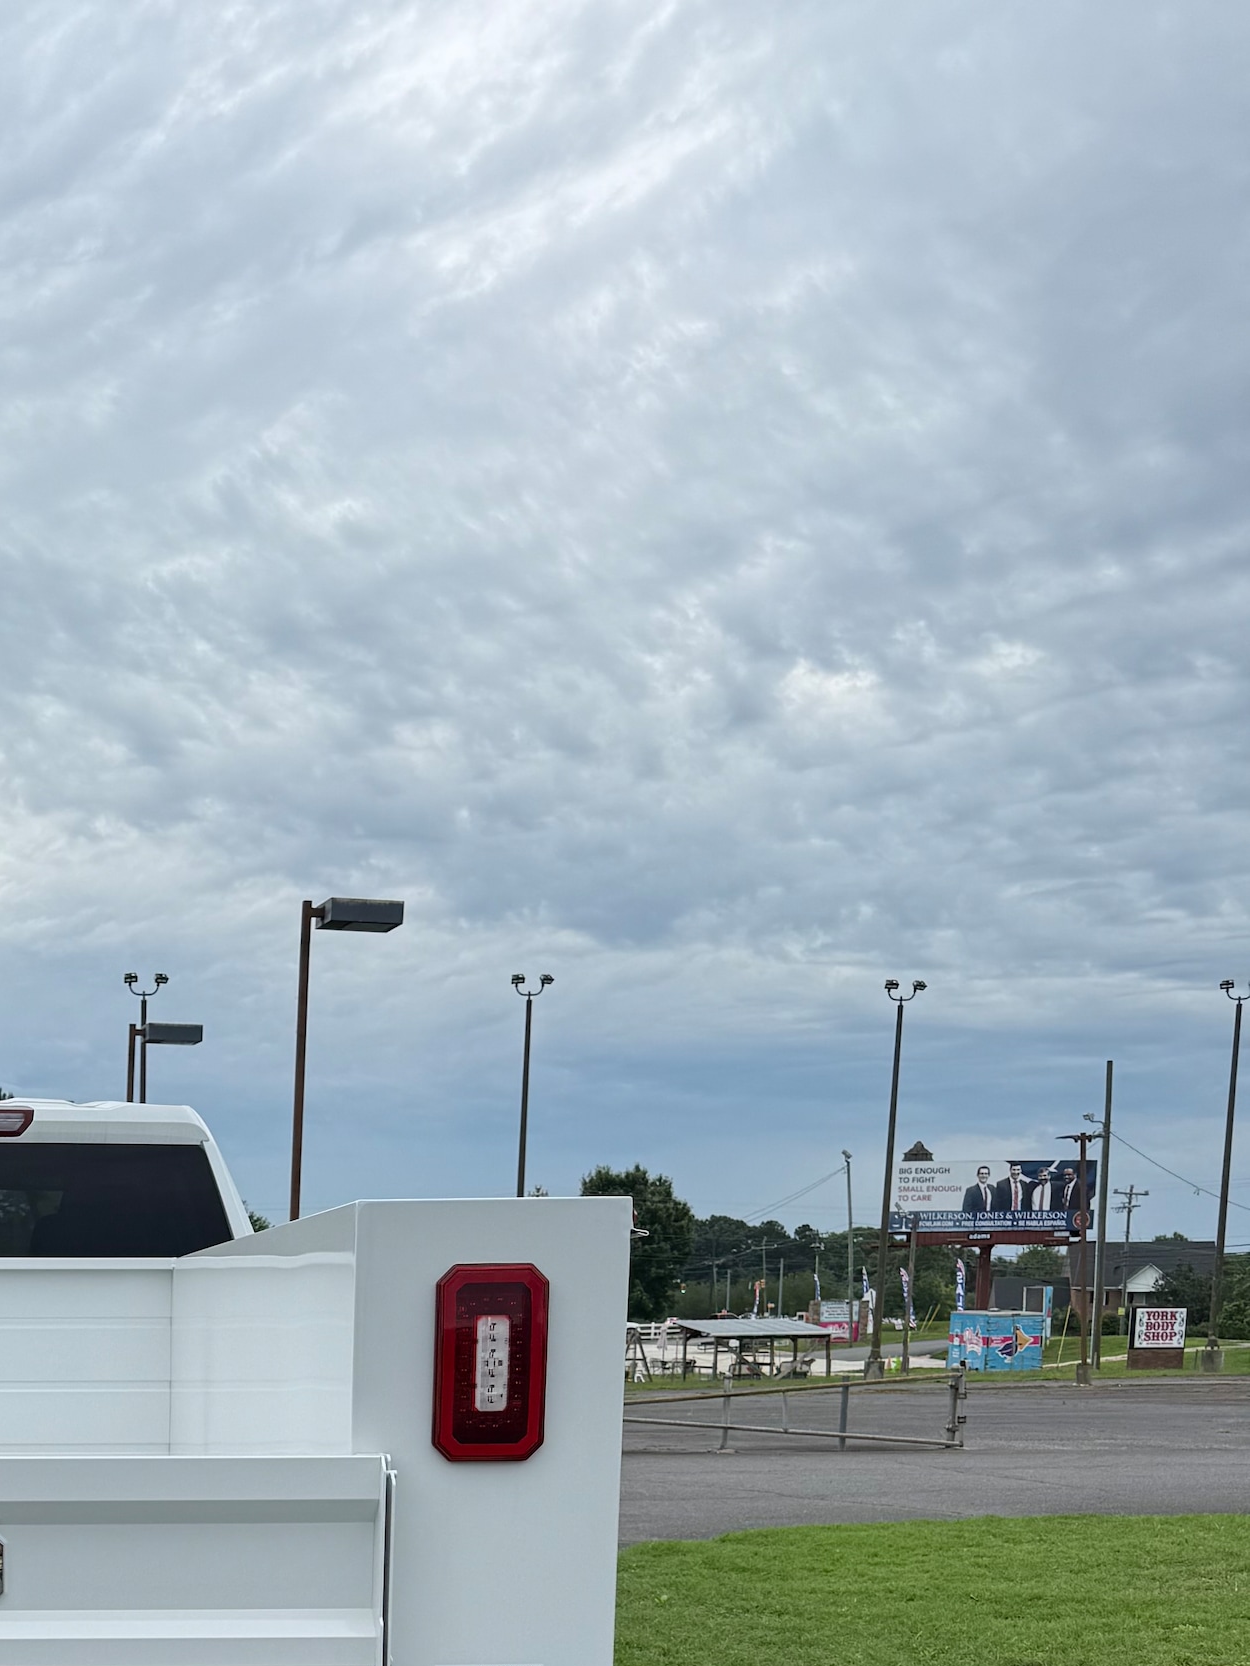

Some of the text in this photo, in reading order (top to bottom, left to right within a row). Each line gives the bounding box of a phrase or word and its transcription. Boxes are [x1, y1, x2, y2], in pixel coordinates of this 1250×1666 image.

[898, 1167, 951, 1175] BIG ENOUGH
[898, 1176, 936, 1184] TO FIGHT
[897, 1185, 962, 1193] SMALL ENOUGH
[897, 1194, 932, 1202] TO CARE
[976, 1211, 1004, 1221] JONES
[1005, 1211, 1014, 1220] &
[1014, 1211, 1067, 1220] WILKERSON
[968, 1232, 991, 1240] adams
[1145, 1310, 1179, 1321] YORK
[1144, 1321, 1177, 1331] BODY
[1143, 1331, 1177, 1342] SHOP
